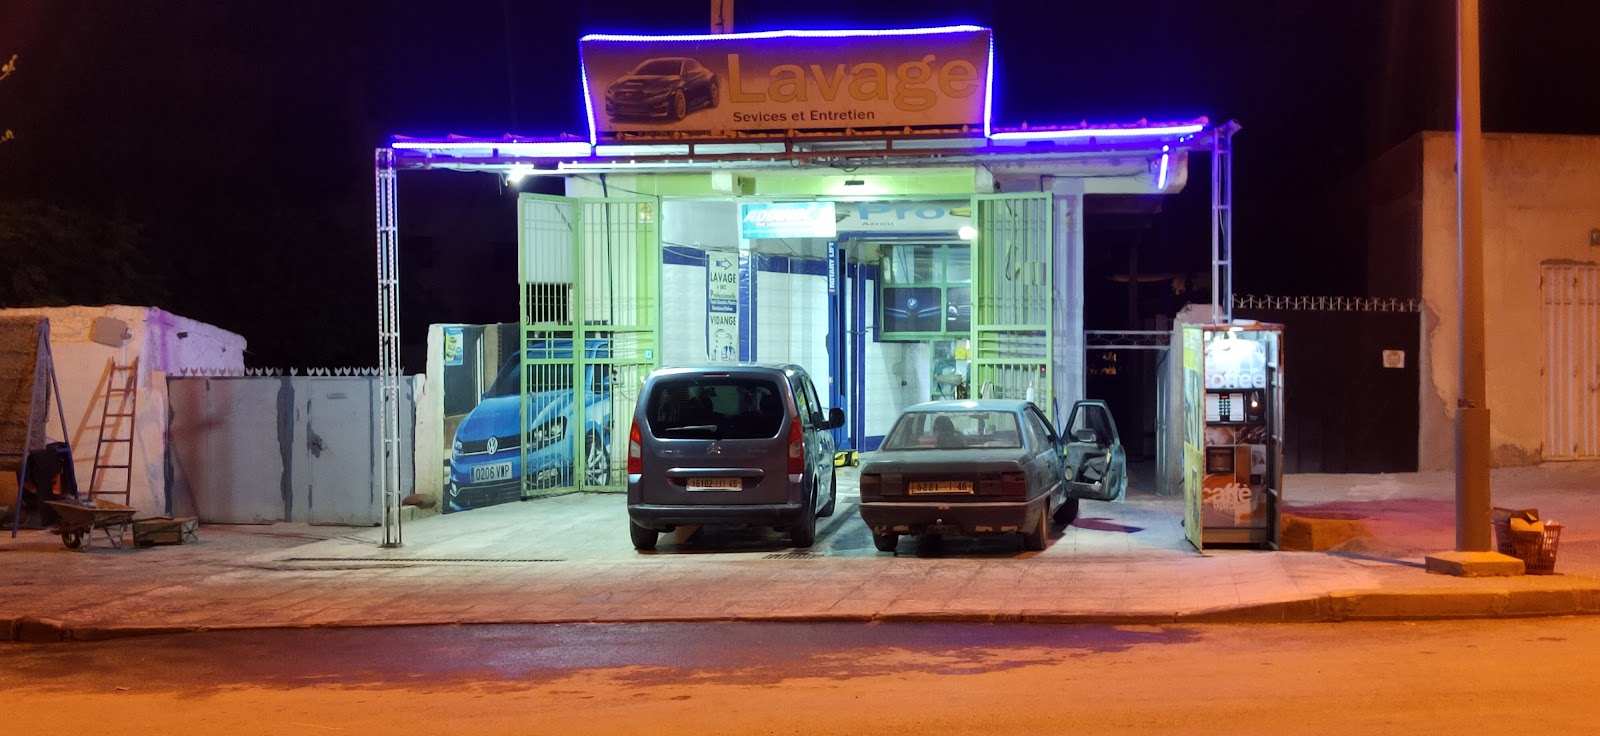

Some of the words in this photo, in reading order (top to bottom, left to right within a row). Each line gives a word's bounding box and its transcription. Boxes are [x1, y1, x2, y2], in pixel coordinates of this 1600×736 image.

[727, 53, 979, 112] Lavage
[733, 111, 788, 123] Sevices
[791, 111, 805, 121] et
[810, 109, 875, 121] Entretien
[858, 203, 945, 220] Pro
[710, 272, 736, 284] LAVAGE
[710, 315, 736, 326] VIDANGE
[476, 466, 494, 481] 0206
